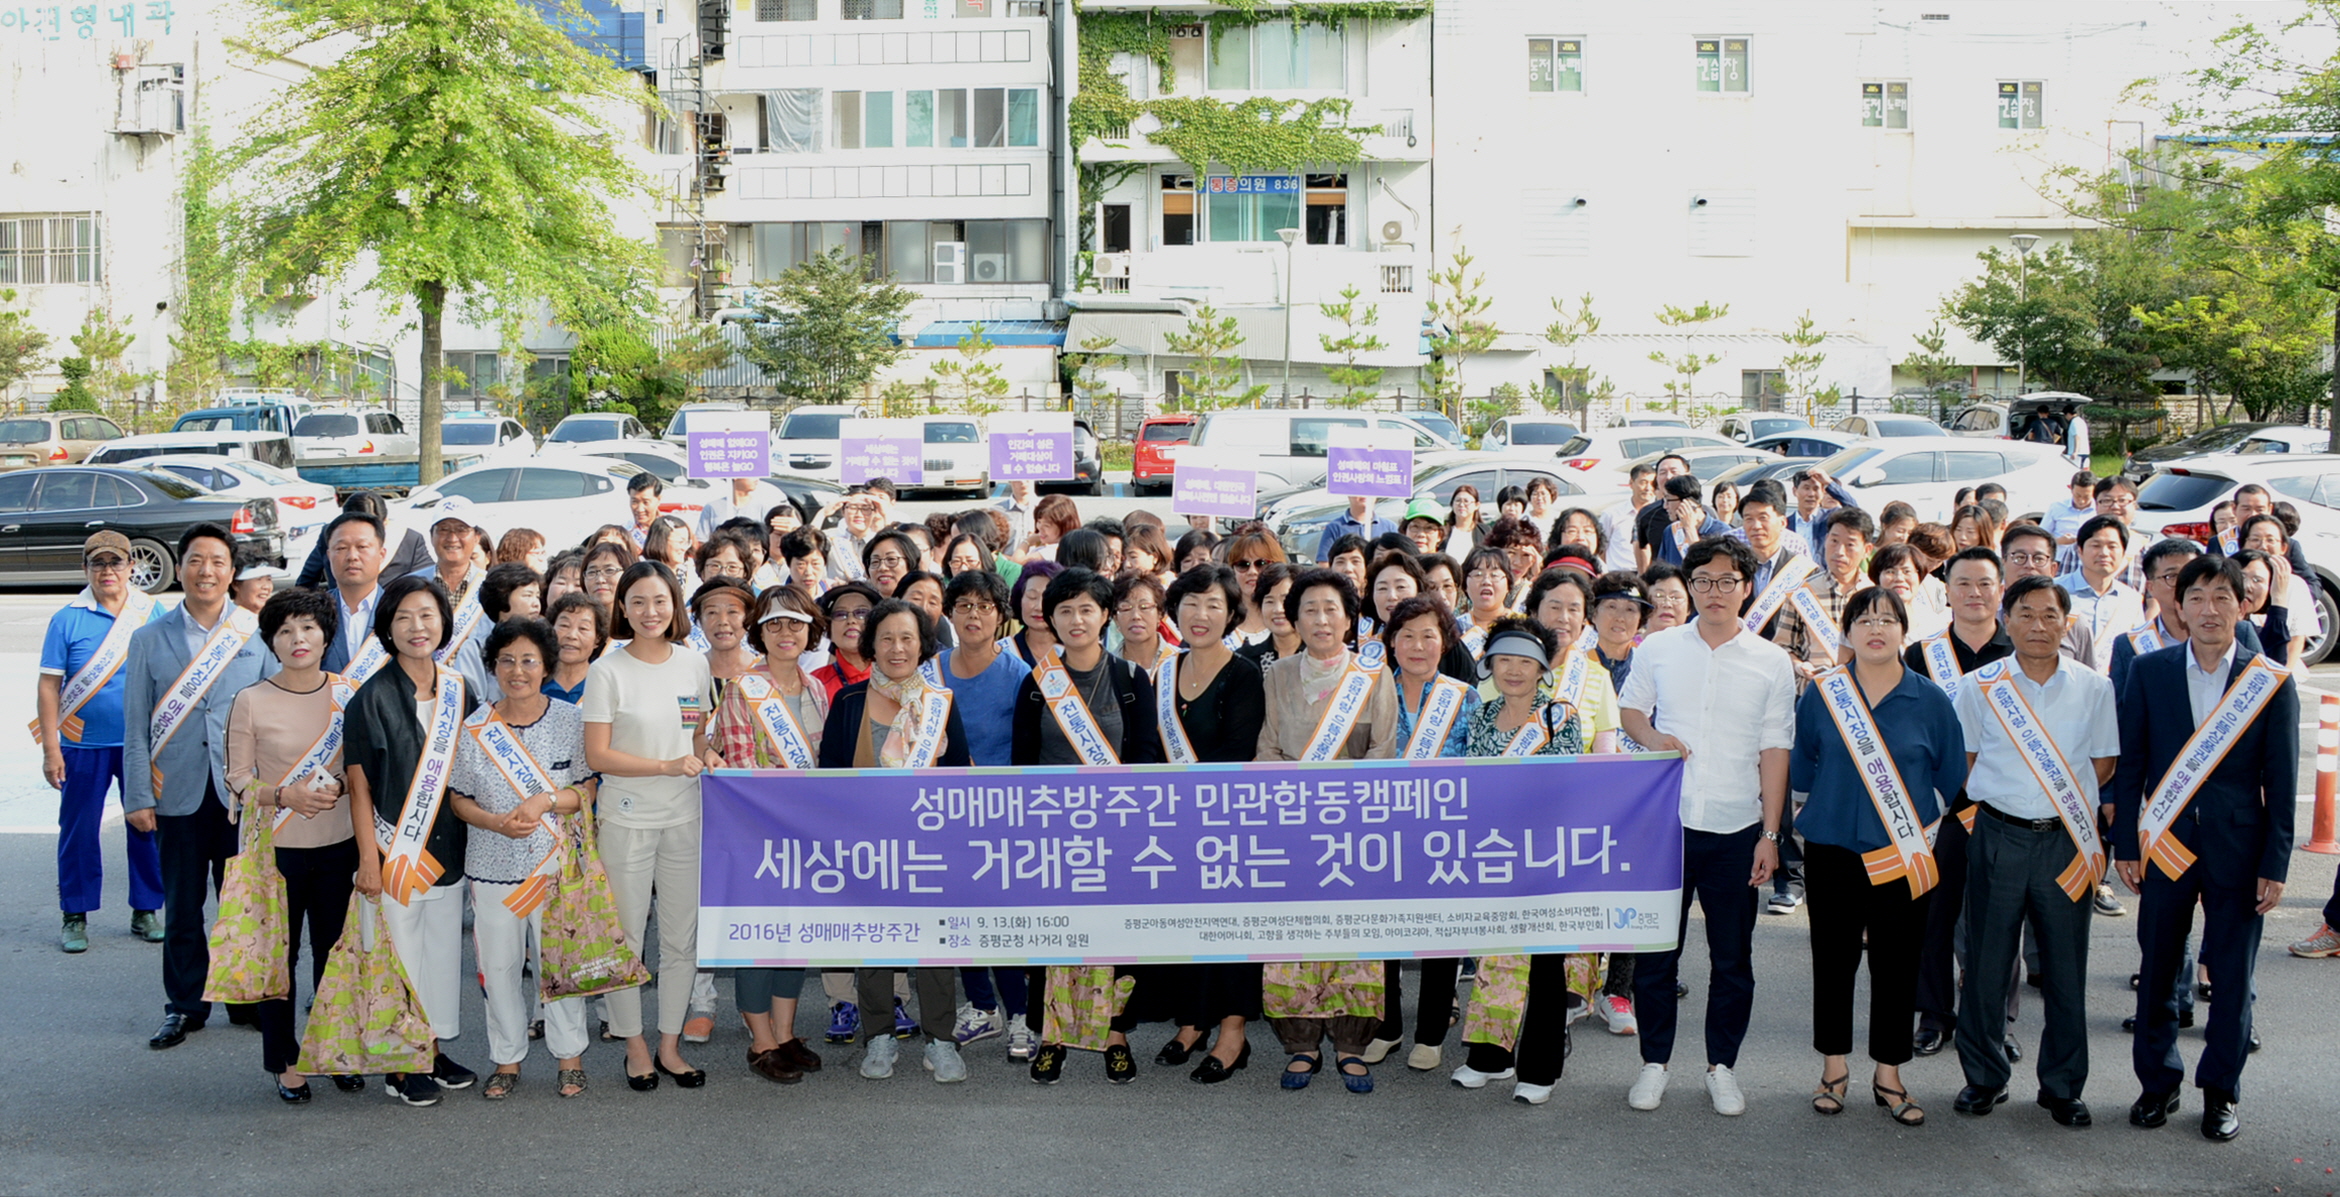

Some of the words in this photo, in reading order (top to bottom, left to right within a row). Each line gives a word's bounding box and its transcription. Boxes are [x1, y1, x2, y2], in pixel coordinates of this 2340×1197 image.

[1211, 177, 1266, 192] 통증의원
[871, 456, 881, 466] 수
[1008, 439, 1034, 450] 인간의
[1013, 463, 1024, 474] 수
[1025, 463, 1061, 474] 없습니다
[180, 634, 237, 699] 전통시장을
[1931, 643, 1952, 680] 증평사랑
[1338, 676, 1365, 714] 증평사랑
[1429, 688, 1454, 727] 증평사랑
[2233, 671, 2269, 713] 증평사랑
[432, 679, 457, 755] 전통시장을
[925, 697, 943, 737] 증평사랑
[1828, 677, 1876, 755] 전통시장을
[1867, 757, 1915, 839] 애용합시다
[2185, 712, 2237, 773] 으뜸상품권을
[1994, 685, 2027, 728] 증평사랑
[2021, 729, 2068, 792] 으뜸상품권을
[2061, 791, 2093, 843] 애용합시다
[403, 758, 444, 842] 애용합시다
[910, 784, 1180, 831] 성매매추방주간
[1195, 777, 1469, 827] 민관합동캠페인
[2152, 770, 2192, 822] 애용합시다
[754, 838, 948, 894] 세상에는
[967, 836, 1112, 893] 거래할
[1131, 835, 1177, 890] 수
[1195, 833, 1291, 890] 없는
[1310, 831, 1402, 888] 것이
[1424, 824, 1632, 885] 있습니다.
[729, 923, 791, 943] 2016년
[797, 922, 920, 943] 성매매추방주간
[948, 916, 971, 929] 일시
[977, 916, 989, 929] 9.
[992, 916, 1032, 930] 13.(화)
[1036, 915, 1069, 928] 16:00
[1124, 917, 1240, 929] 증평군아동여성안전지역연대,
[1242, 915, 1332, 928] 증평군여성단체협의회,
[1335, 913, 1444, 925] 증평군다문화가족지원센터,
[1446, 910, 1519, 923] 소비자교육중앙회,
[1522, 906, 1603, 920] 한국여성소비자연합,
[1199, 930, 1255, 942] 대한어머니회,
[1257, 929, 1284, 941] 고향을
[1286, 928, 1322, 940] 생각하는
[1324, 928, 1360, 940] 주부들의
[1362, 927, 1383, 939] 모임,
[1385, 926, 1432, 938] 아이코리아,
[1434, 924, 1507, 937] 적십자부녀봉사회,
[1510, 922, 1557, 935] 생활개선회,
[1559, 920, 1603, 932] 한국부인회
[948, 934, 971, 948] 장소
[979, 934, 1024, 948] 증평군청
[1027, 934, 1062, 948] 사거리
[1065, 934, 1089, 948] 일원
